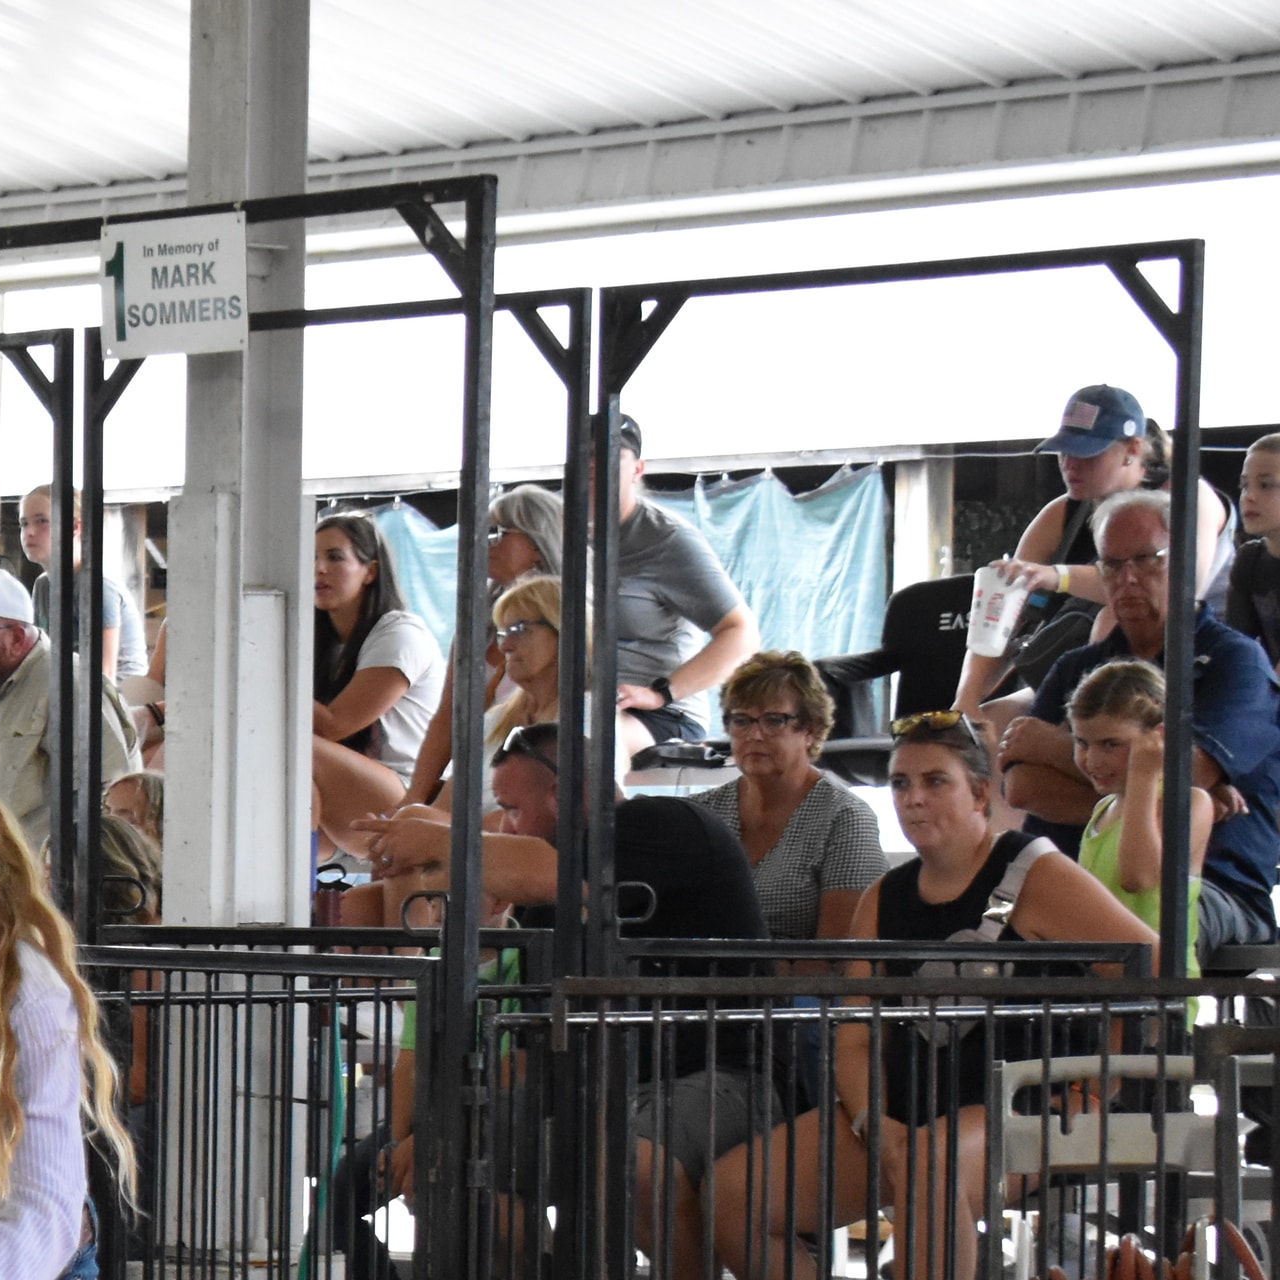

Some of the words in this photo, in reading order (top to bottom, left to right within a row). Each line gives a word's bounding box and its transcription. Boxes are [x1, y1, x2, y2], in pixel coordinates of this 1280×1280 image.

[143, 245, 154, 257] In
[158, 242, 204, 256] Memory
[208, 238, 220, 251] of
[151, 261, 217, 290] MARK
[105, 241, 126, 342] 1
[127, 294, 242, 328] SOMMERS
